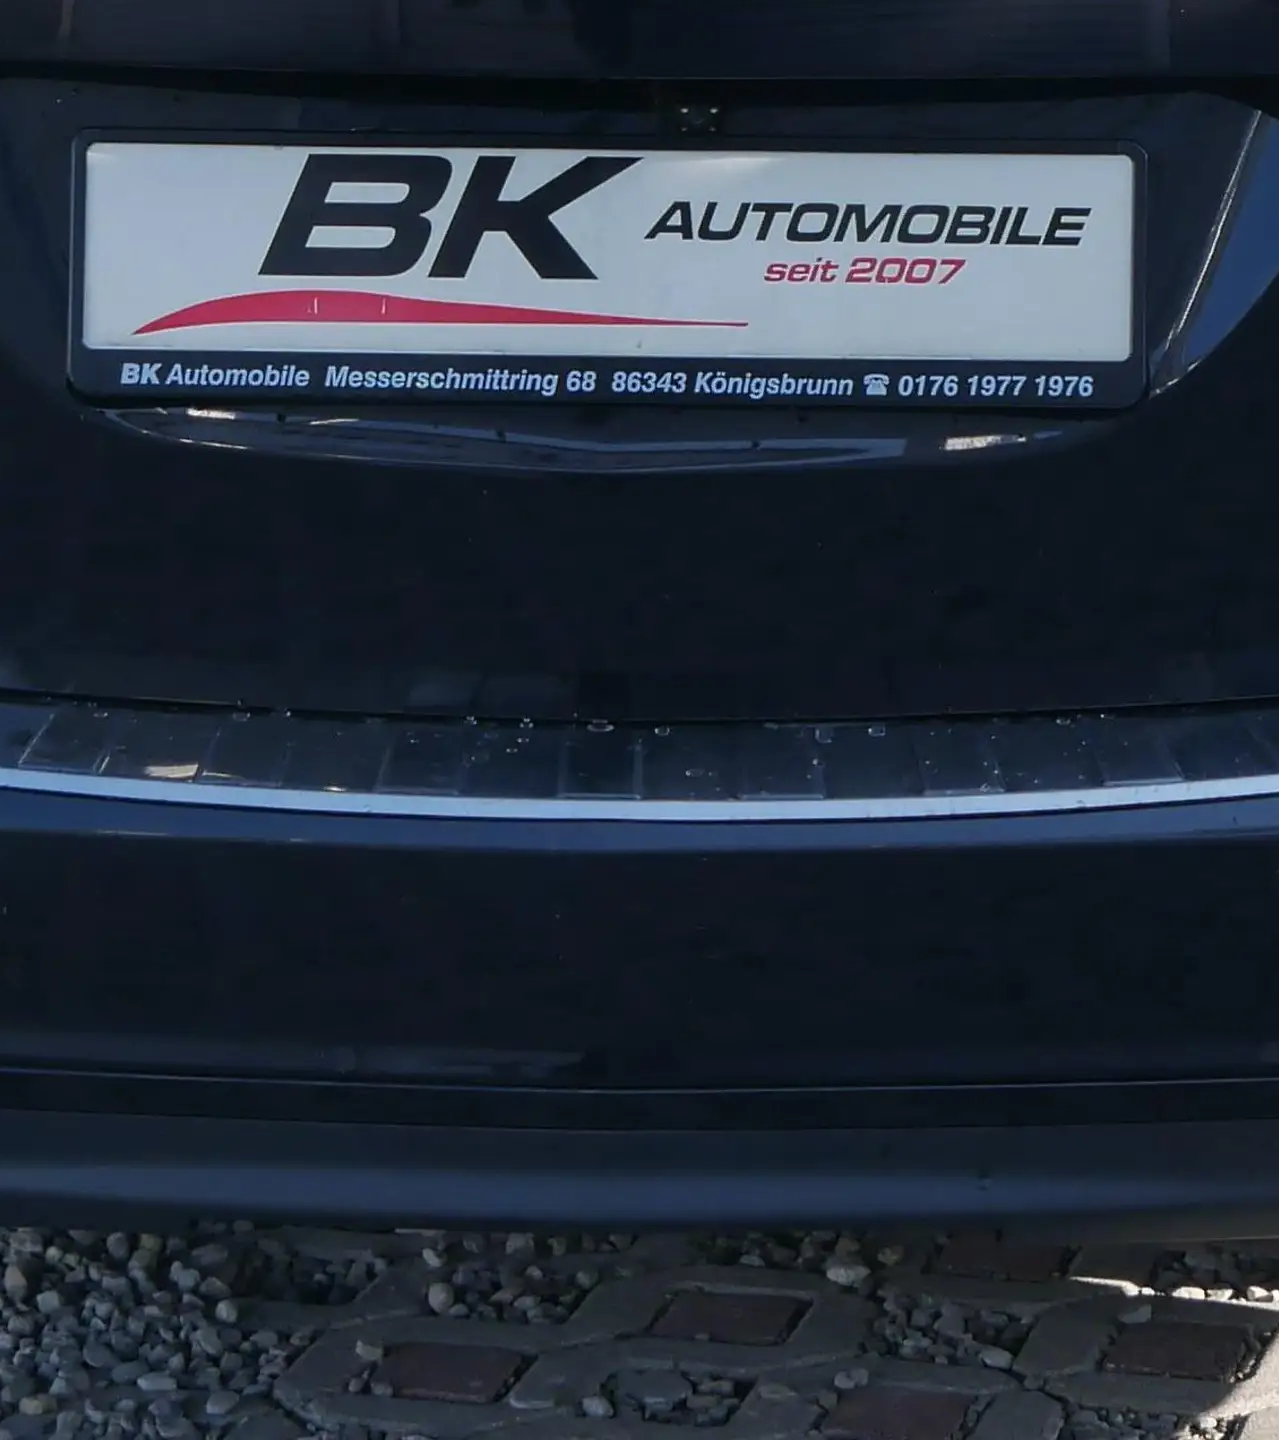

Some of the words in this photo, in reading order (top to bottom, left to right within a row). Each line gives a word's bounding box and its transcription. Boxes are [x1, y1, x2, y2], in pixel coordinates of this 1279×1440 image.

[258, 153, 645, 280] BK
[644, 201, 1092, 246] AUTOMOBILE
[763, 257, 839, 283] seit
[845, 257, 966, 284] 2007
[120, 363, 160, 386] BK
[165, 363, 310, 388] Automobile
[324, 366, 559, 397] Messerschmittring
[566, 371, 597, 392] 68
[611, 371, 687, 394] 86343
[693, 371, 854, 400] Königsbrunn
[898, 375, 959, 397] 0176
[967, 375, 1027, 397] 1977
[1034, 376, 1095, 398] 1976
